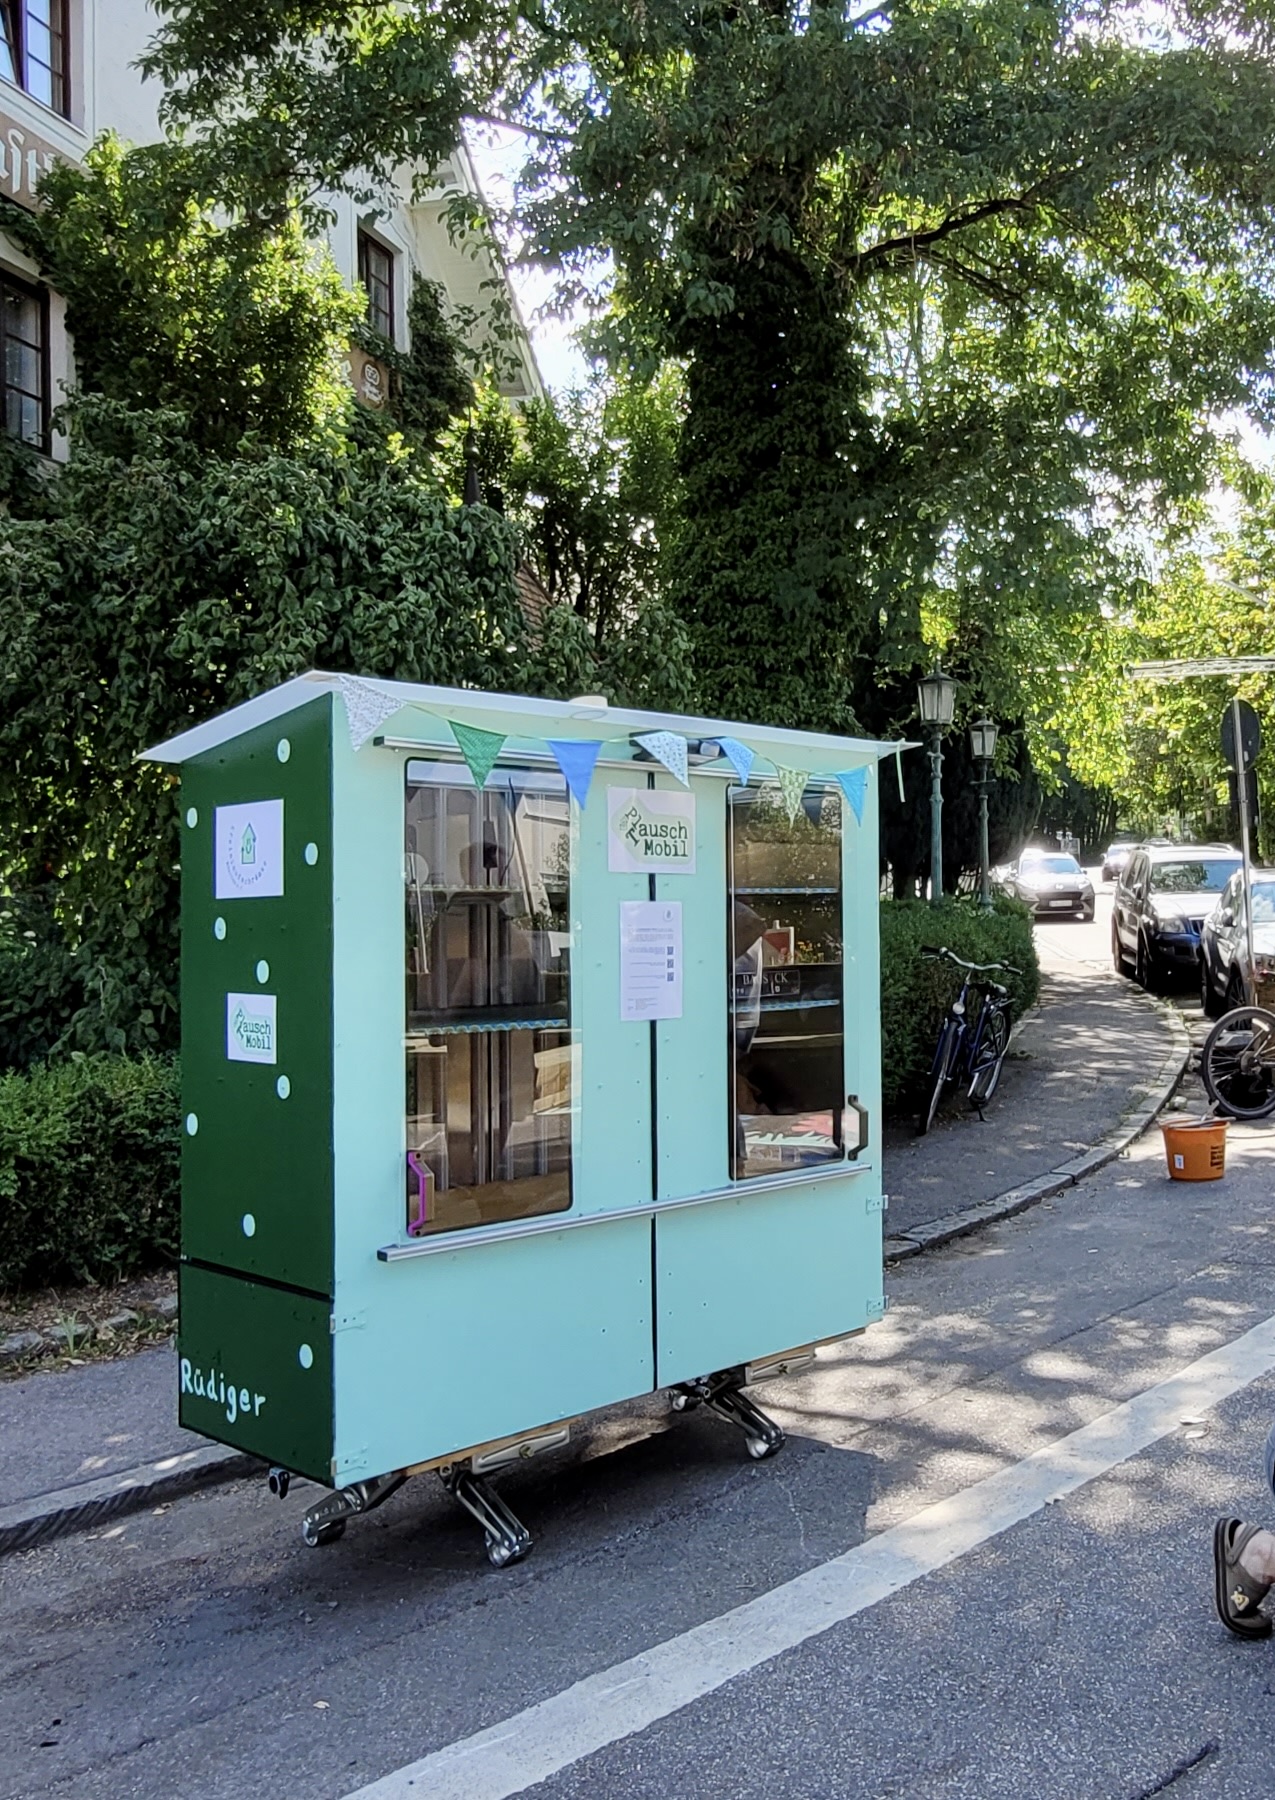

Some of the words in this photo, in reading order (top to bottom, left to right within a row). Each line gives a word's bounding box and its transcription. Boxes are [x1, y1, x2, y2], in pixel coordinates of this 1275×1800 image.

[644, 839, 688, 857] Mobil
[246, 1034, 271, 1050] Mobil
[181, 1358, 266, 1424] Rüdiger
